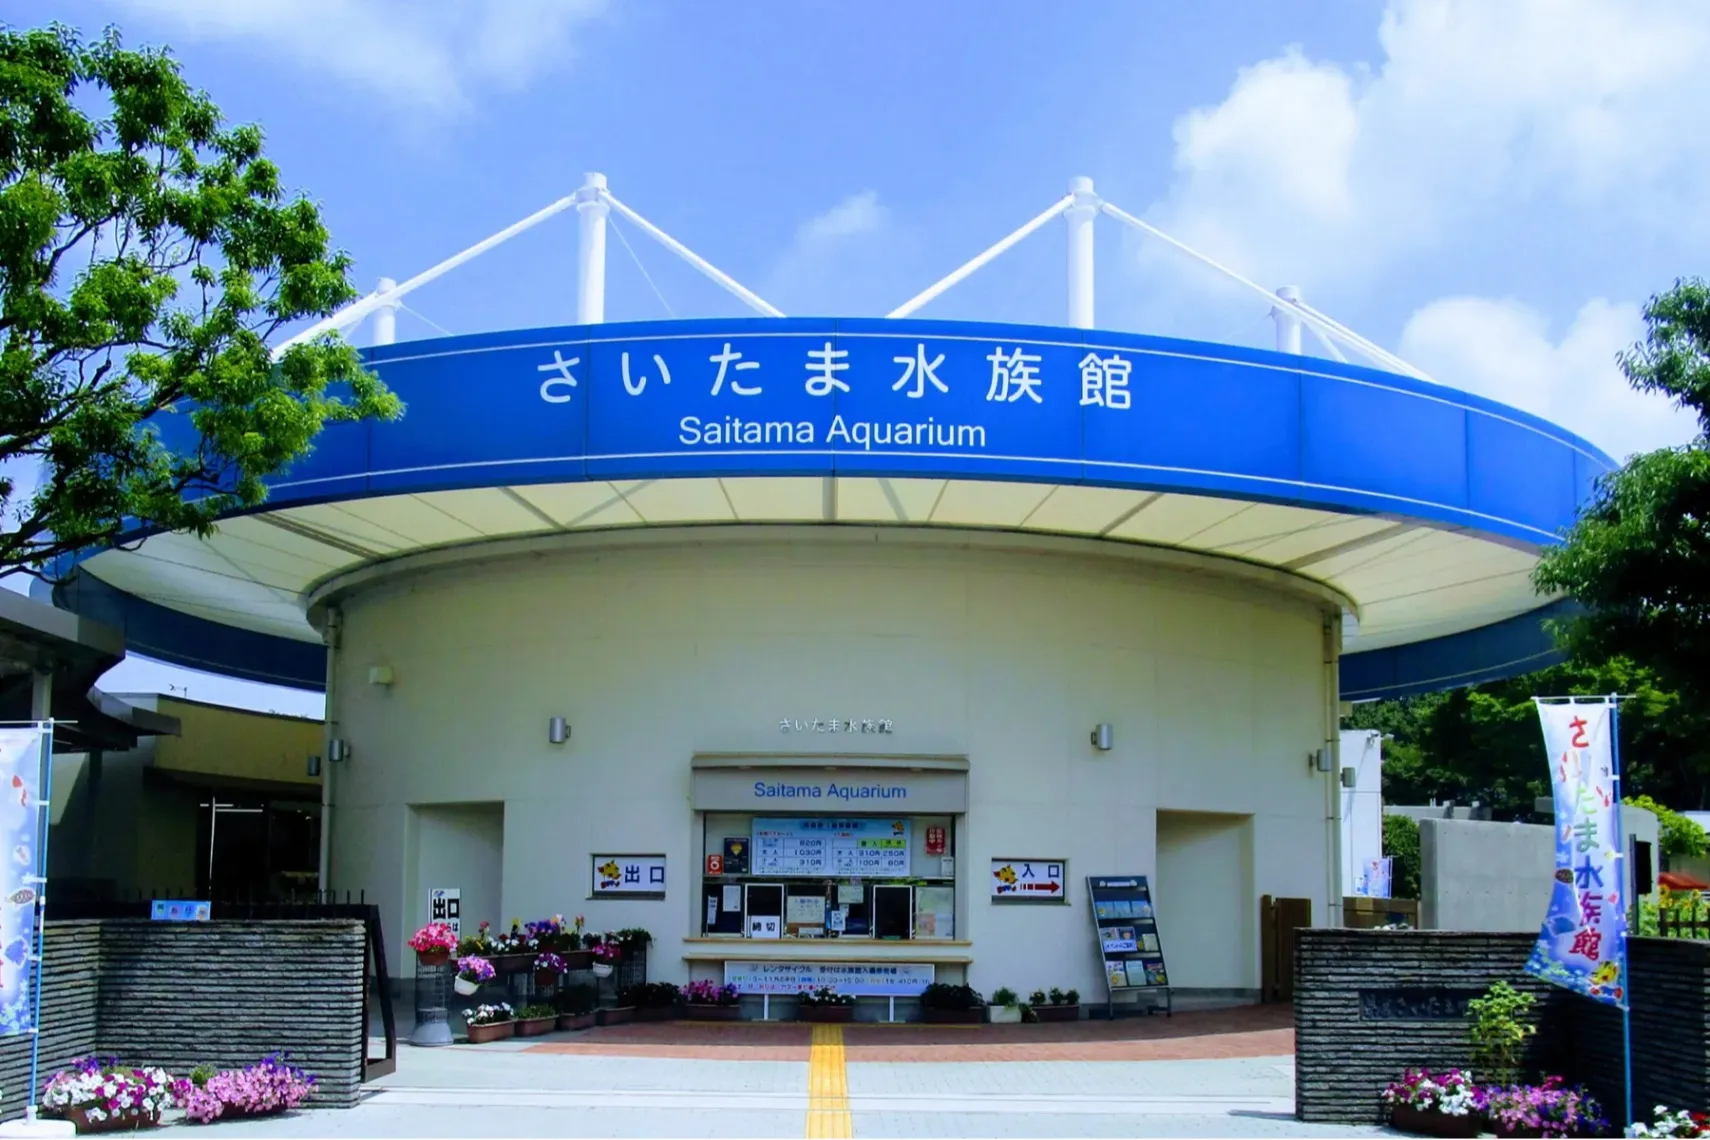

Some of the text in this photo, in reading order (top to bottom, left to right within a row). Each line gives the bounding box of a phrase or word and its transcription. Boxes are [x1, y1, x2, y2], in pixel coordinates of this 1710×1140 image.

[536, 342, 1133, 410] さいたま水族館
[678, 415, 986, 450] Saitama Aquarium
[779, 717, 893, 734] さいたま水族館
[754, 782, 907, 801] Saitama Aquarium
[624, 865, 665, 884] 出口
[1021, 864, 1060, 878] 入口
[433, 898, 460, 920] 出口
